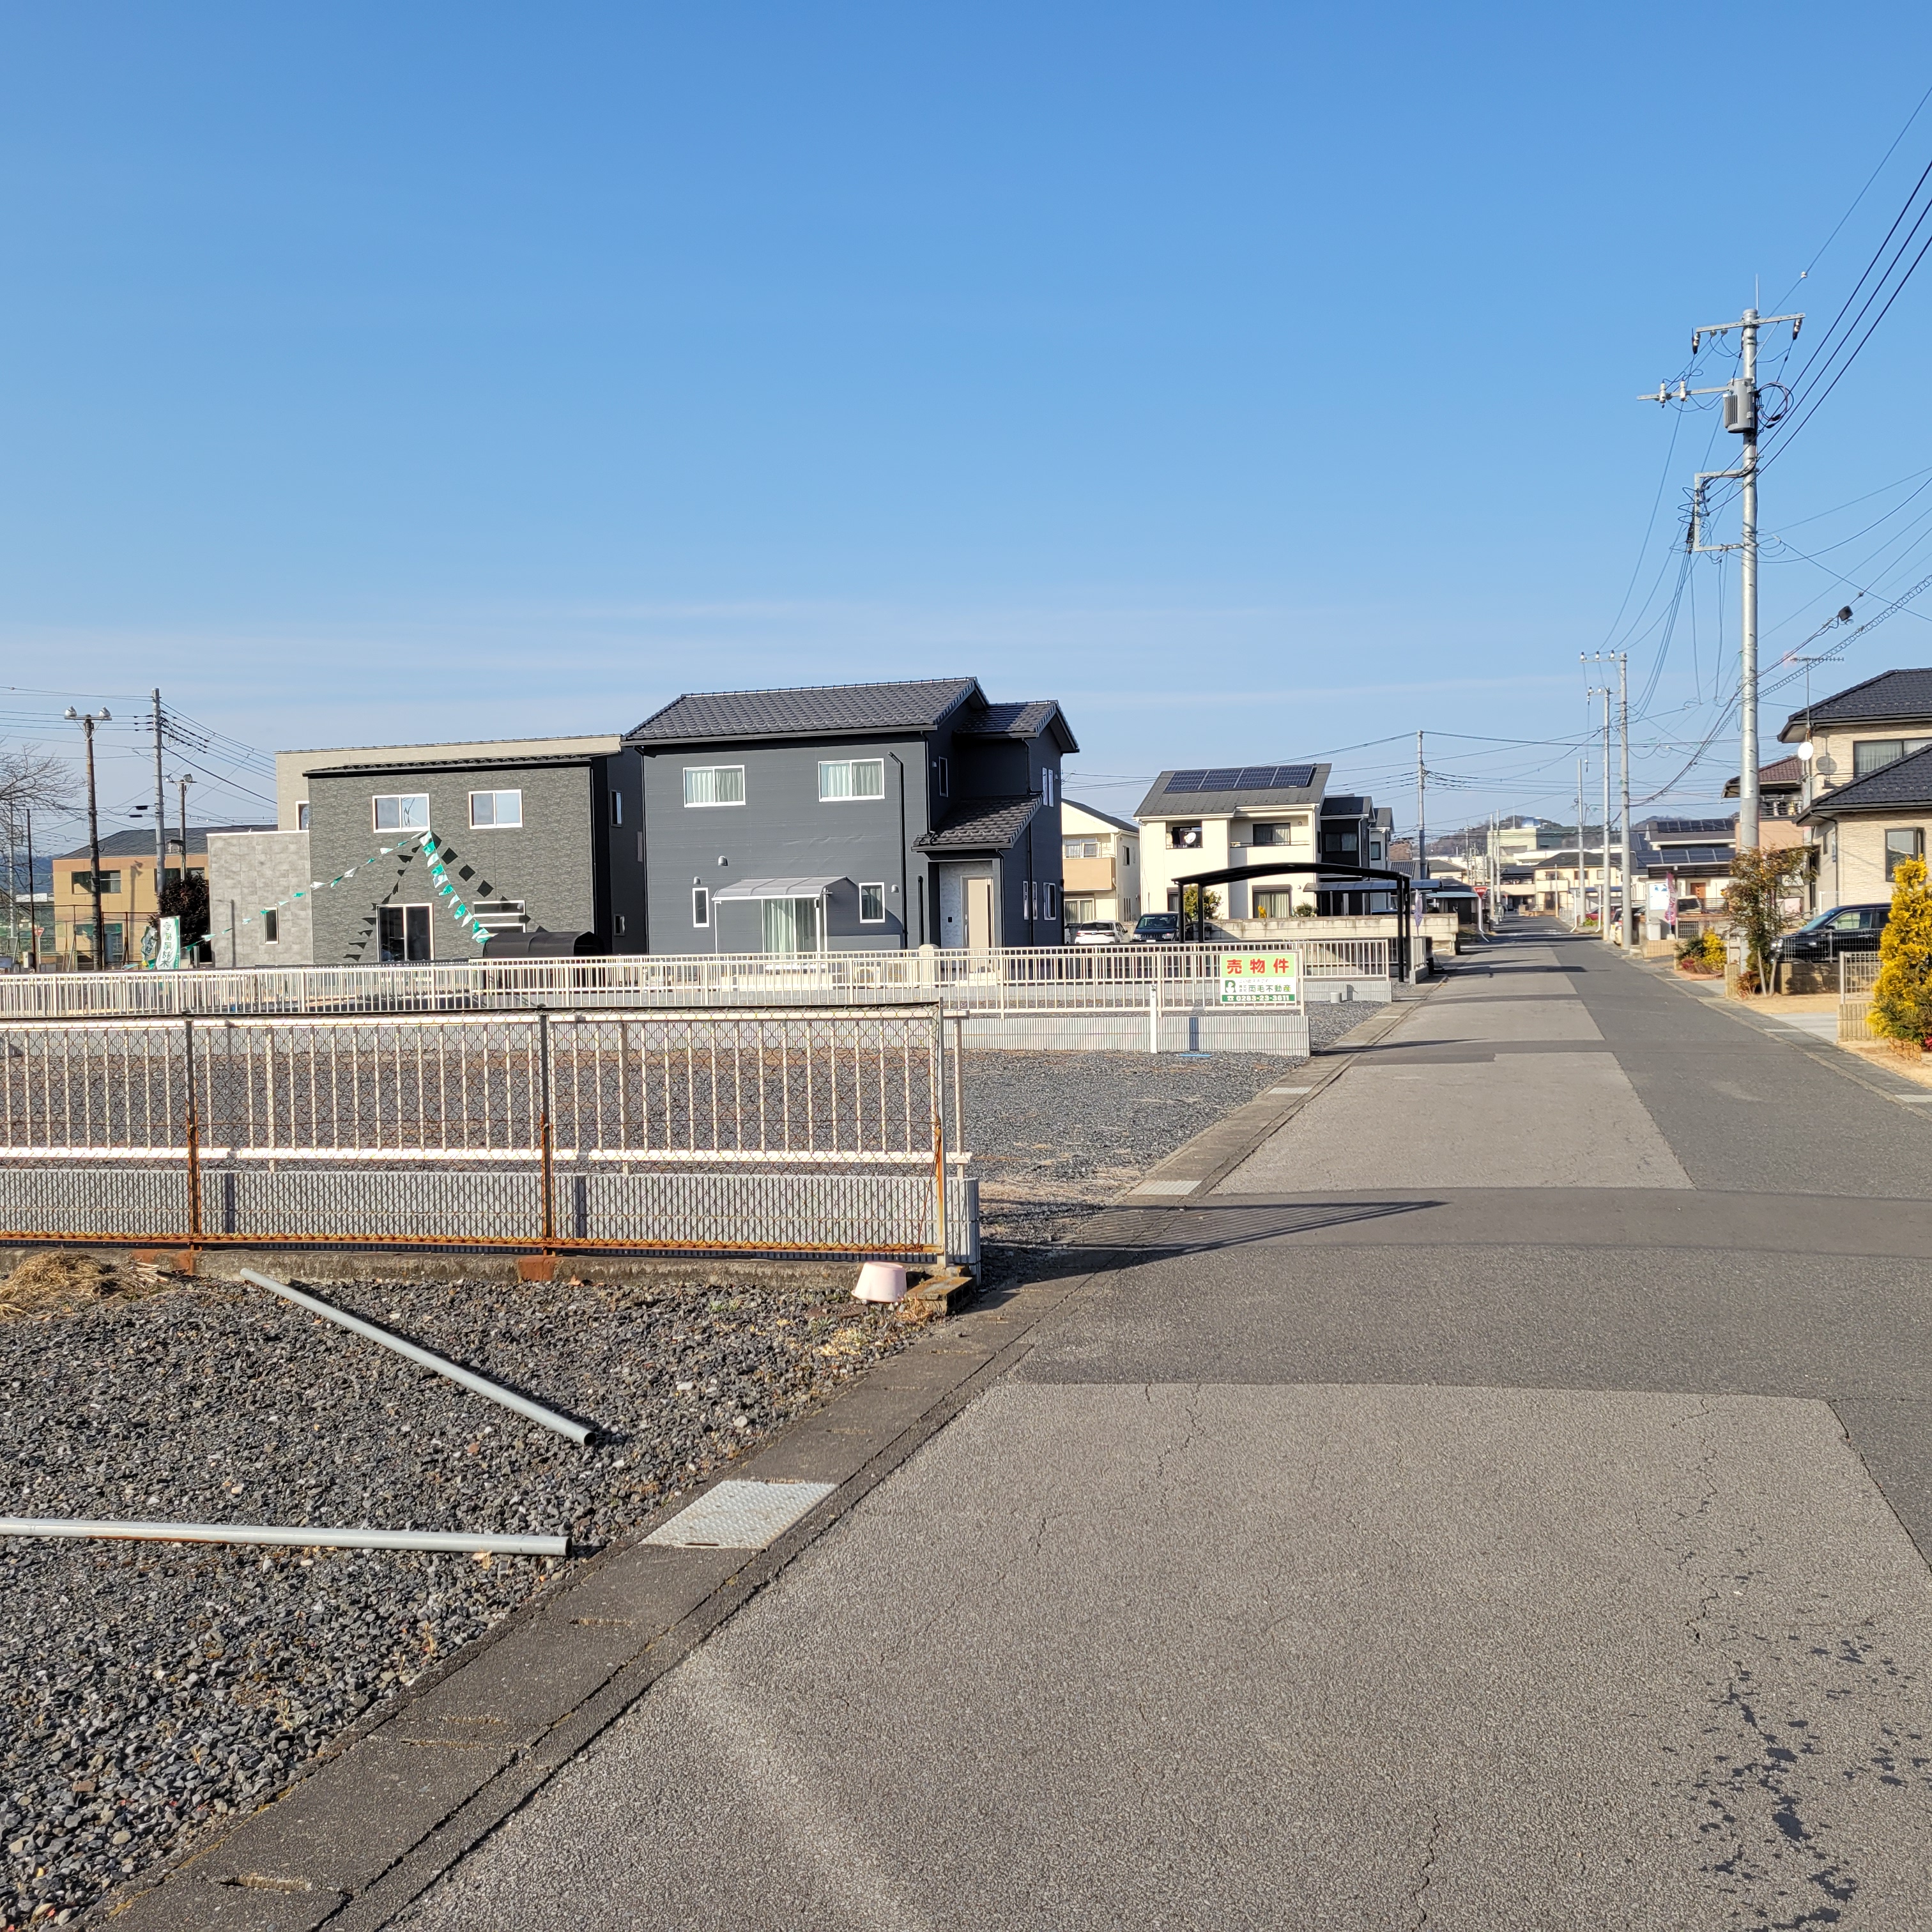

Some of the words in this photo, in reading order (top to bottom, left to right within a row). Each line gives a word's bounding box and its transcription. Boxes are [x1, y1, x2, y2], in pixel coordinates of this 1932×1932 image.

[1226, 958, 1289, 974] 売物件
[1248, 985, 1291, 993] 両毛不動産
